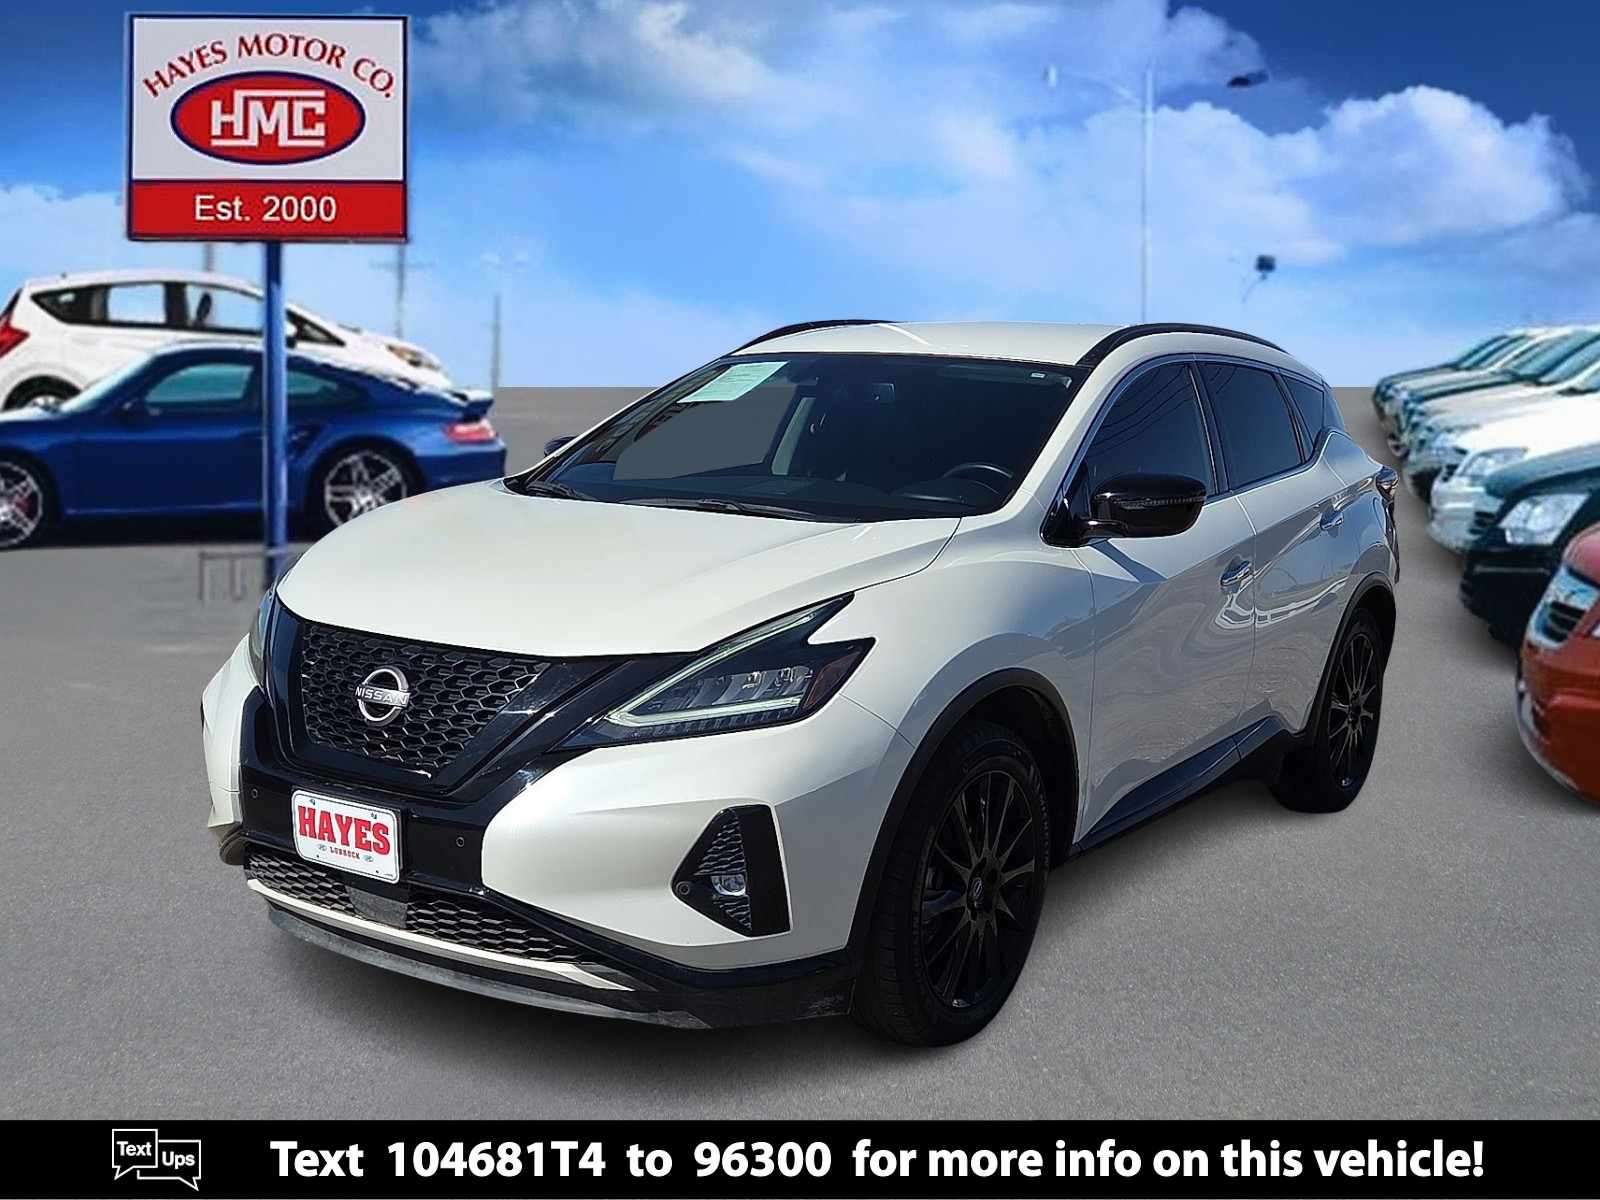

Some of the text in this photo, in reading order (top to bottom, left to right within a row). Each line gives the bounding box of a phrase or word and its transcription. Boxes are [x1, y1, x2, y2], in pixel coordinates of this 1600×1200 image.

[142, 32, 395, 98] HAYES MOTOR CO.
[210, 89, 326, 147] HMC
[194, 195, 337, 222] Est. 2000
[355, 686, 409, 705] NISSAN
[297, 805, 391, 856] HAYES
